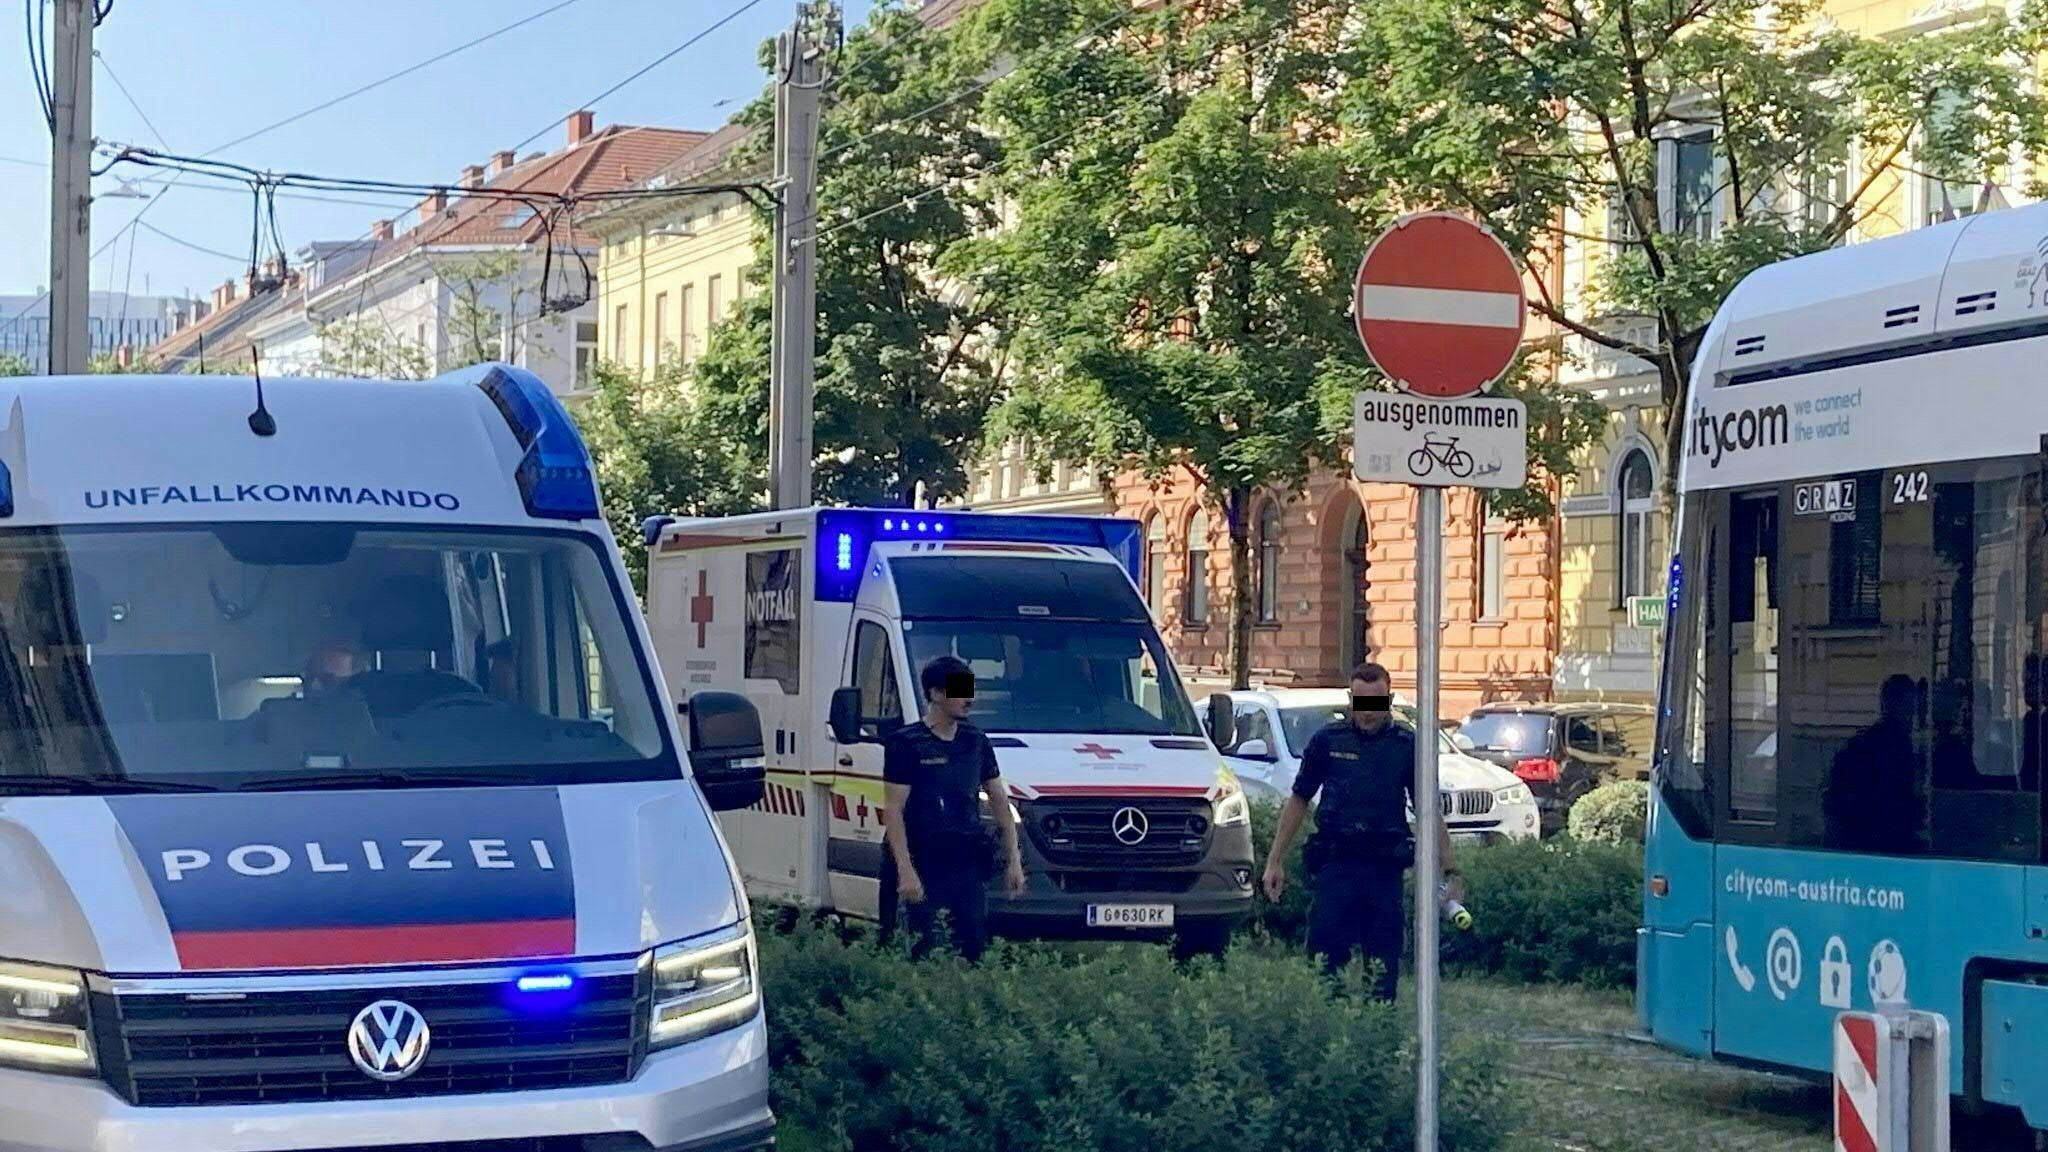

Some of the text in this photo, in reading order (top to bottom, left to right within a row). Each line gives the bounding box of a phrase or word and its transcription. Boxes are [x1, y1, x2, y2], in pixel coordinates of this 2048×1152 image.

[1364, 400, 1519, 431] ausgenommen
[1793, 389, 1862, 416] we connect
[1686, 397, 1789, 469] itycom
[1794, 415, 1850, 441] the world
[85, 484, 461, 511] UNFALLKOMMANDO
[1796, 482, 1855, 512] GRAZ
[1893, 471, 1929, 504] 242
[747, 588, 796, 621] NOTFALL
[162, 840, 555, 882] POLIZEI
[1725, 868, 1905, 911] citycom-austria.com
